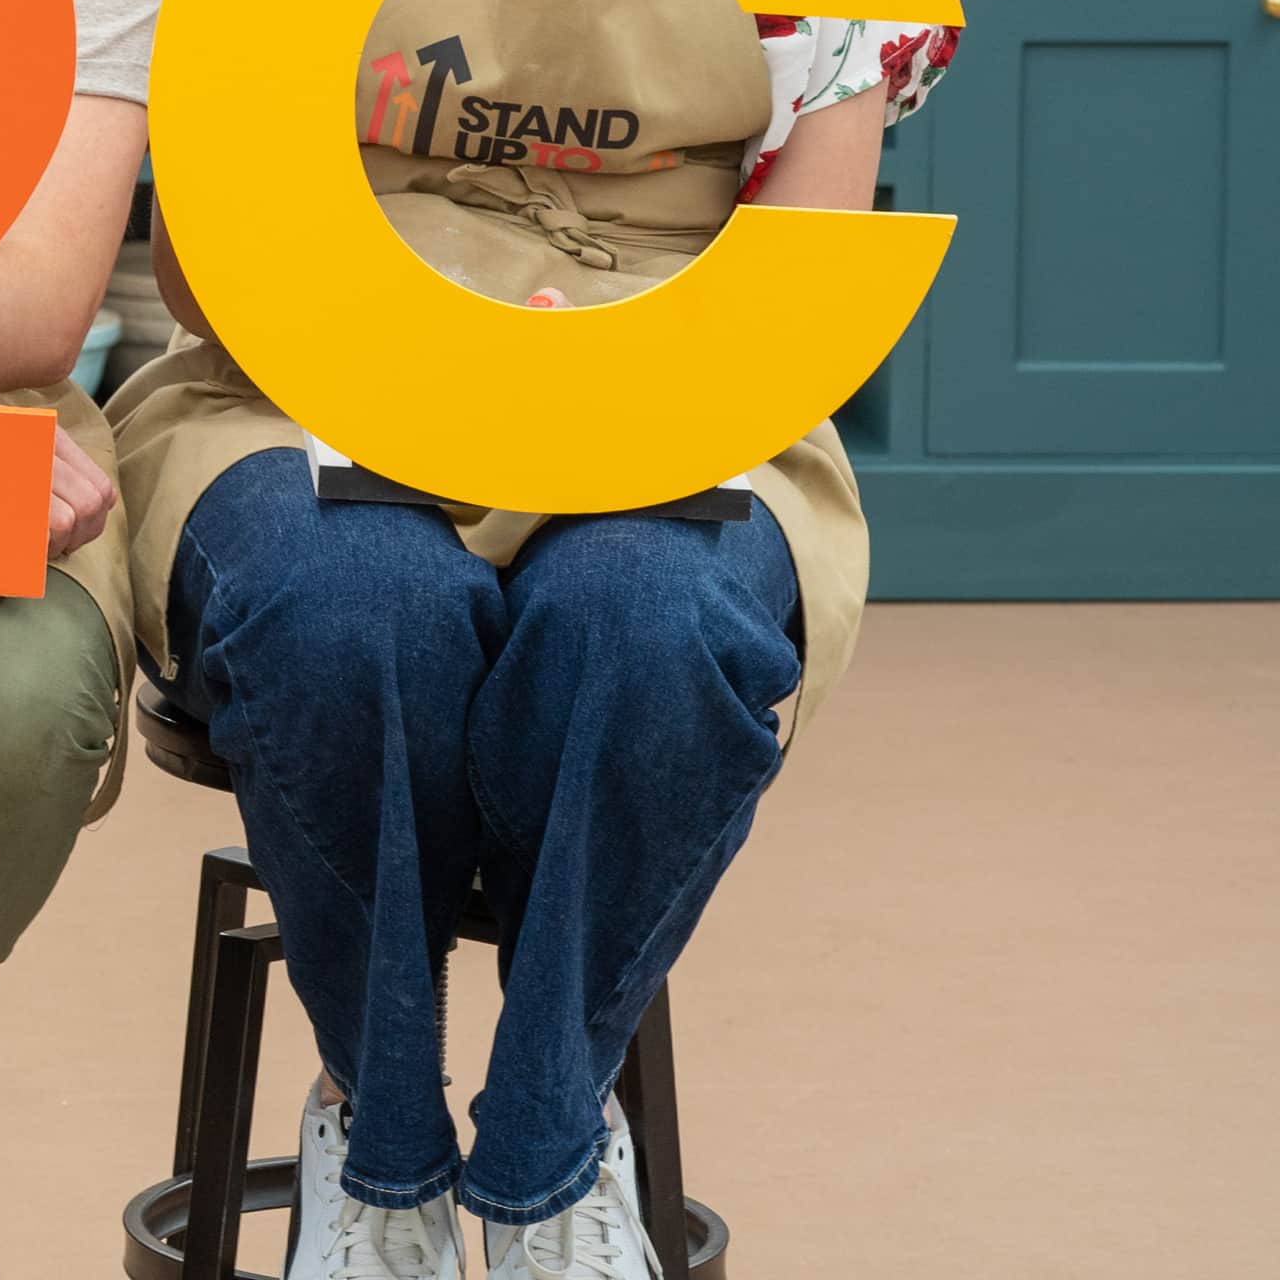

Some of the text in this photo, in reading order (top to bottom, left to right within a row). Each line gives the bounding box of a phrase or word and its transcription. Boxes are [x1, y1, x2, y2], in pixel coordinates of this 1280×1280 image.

[457, 95, 640, 149] STAND
[454, 131, 603, 171] UP TO
